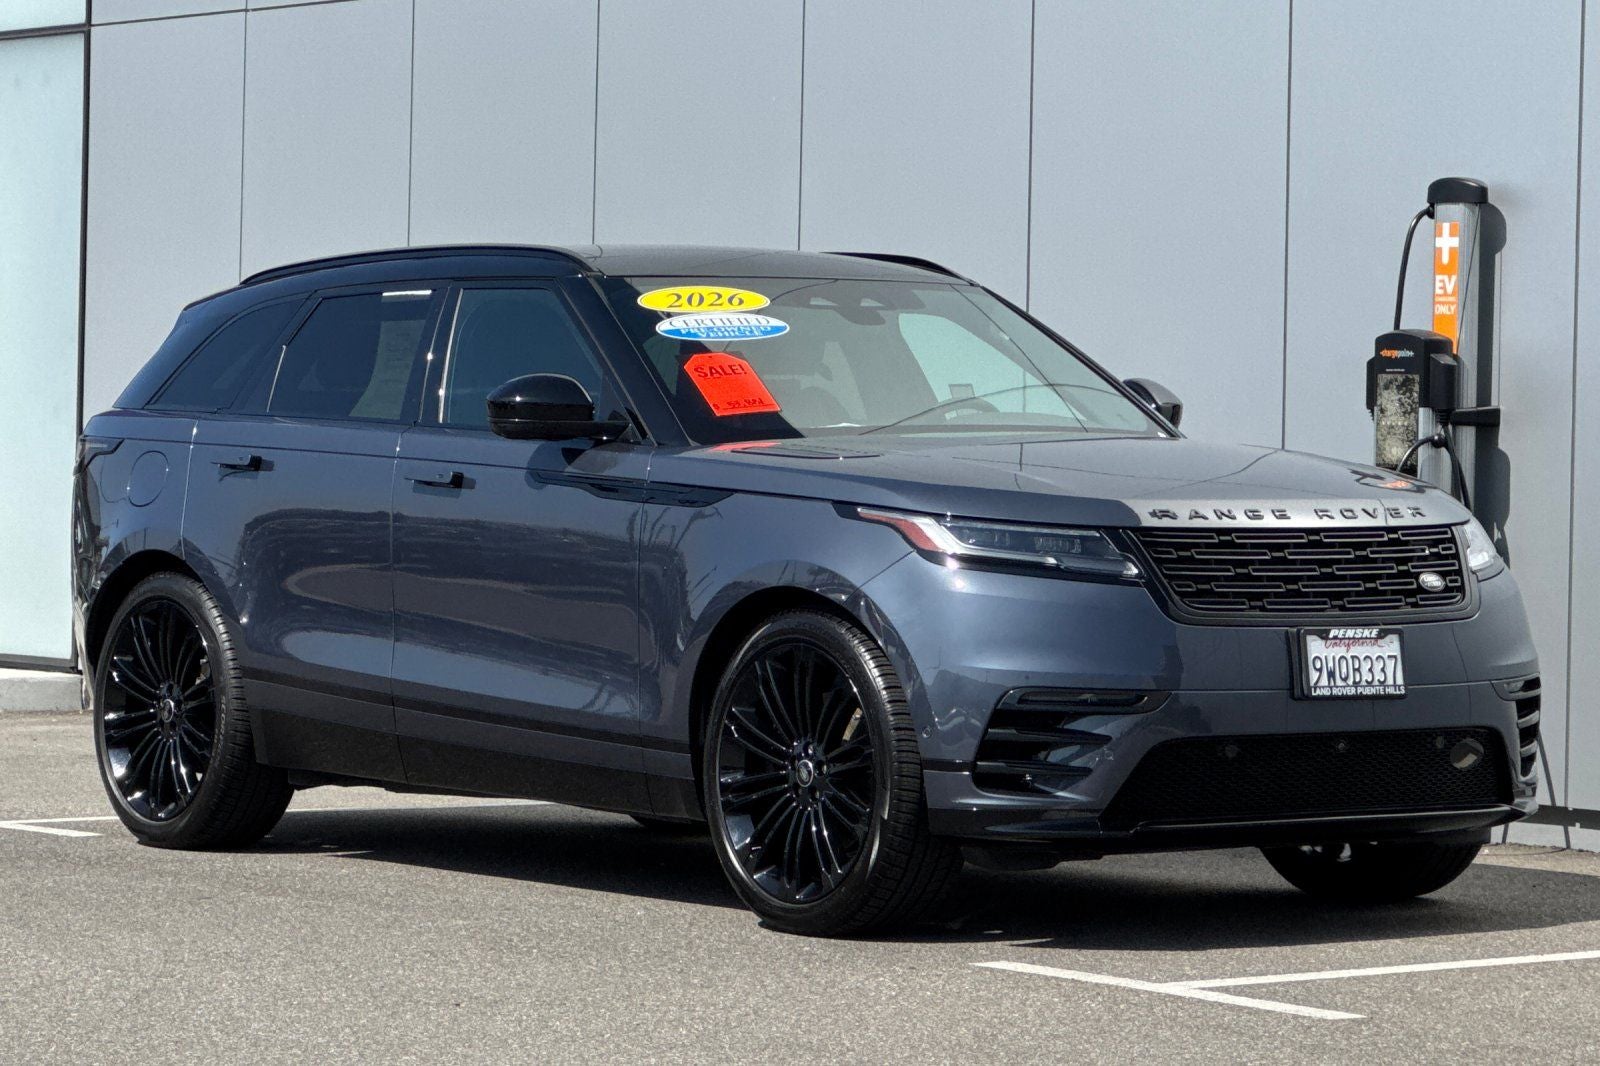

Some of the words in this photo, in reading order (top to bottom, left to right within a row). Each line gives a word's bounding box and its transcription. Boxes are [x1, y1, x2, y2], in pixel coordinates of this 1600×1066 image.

[1435, 274, 1457, 295] EV
[666, 292, 745, 308] 2026
[1435, 303, 1456, 315] ONLY
[669, 317, 770, 328] CERTIFIED
[698, 329, 763, 338] VEHICLE
[694, 364, 747, 379] SALE!
[1149, 508, 1292, 521] RANGE
[1314, 506, 1426, 520] ROVER
[1329, 628, 1380, 638] PENSKE
[1312, 654, 1398, 687] 9WQB337
[1311, 686, 1332, 696] LAND
[1332, 686, 1356, 695] ROVER
[1357, 686, 1384, 695] PUENTE
[1385, 685, 1406, 695] HILLS
